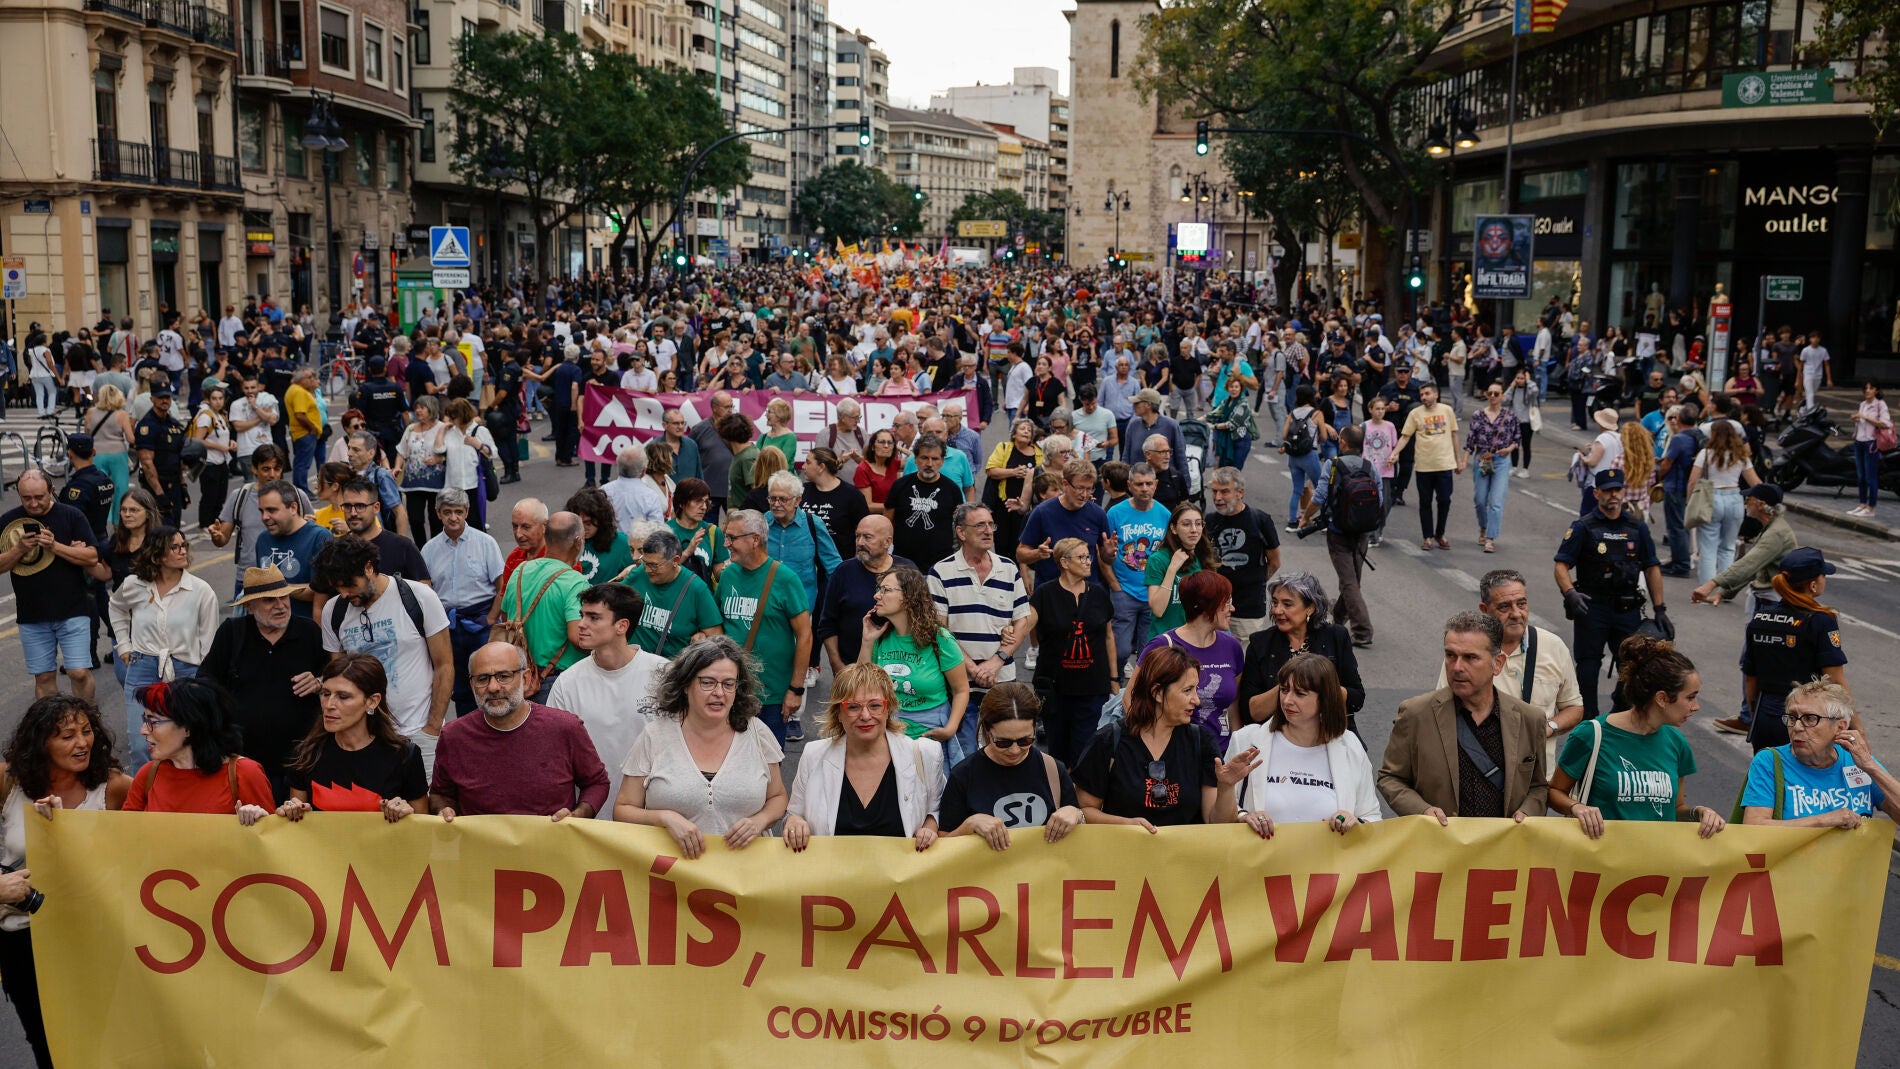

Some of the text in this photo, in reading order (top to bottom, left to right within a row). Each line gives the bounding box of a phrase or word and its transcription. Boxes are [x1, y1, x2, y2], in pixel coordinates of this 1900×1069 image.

[1771, 73, 1818, 82] Universidad
[1770, 82, 1802, 90] Católica
[1770, 89, 1804, 97] Valencia
[1765, 213, 1828, 233] outlet
[1477, 271, 1526, 287] INFILTRADA
[1754, 612, 1794, 624] POLICIA
[344, 618, 393, 635] THE SITHS
[1754, 634, 1785, 645] U.I.P.
[1617, 770, 1673, 798] LA LLENGUA
[1788, 785, 1849, 817] TROBADES
[135, 853, 1784, 988] SOM PAÍS, PARLEM VALENCIÀ
[766, 1002, 1192, 1045] COMISSIÓ 9 D'OCTUBRE
